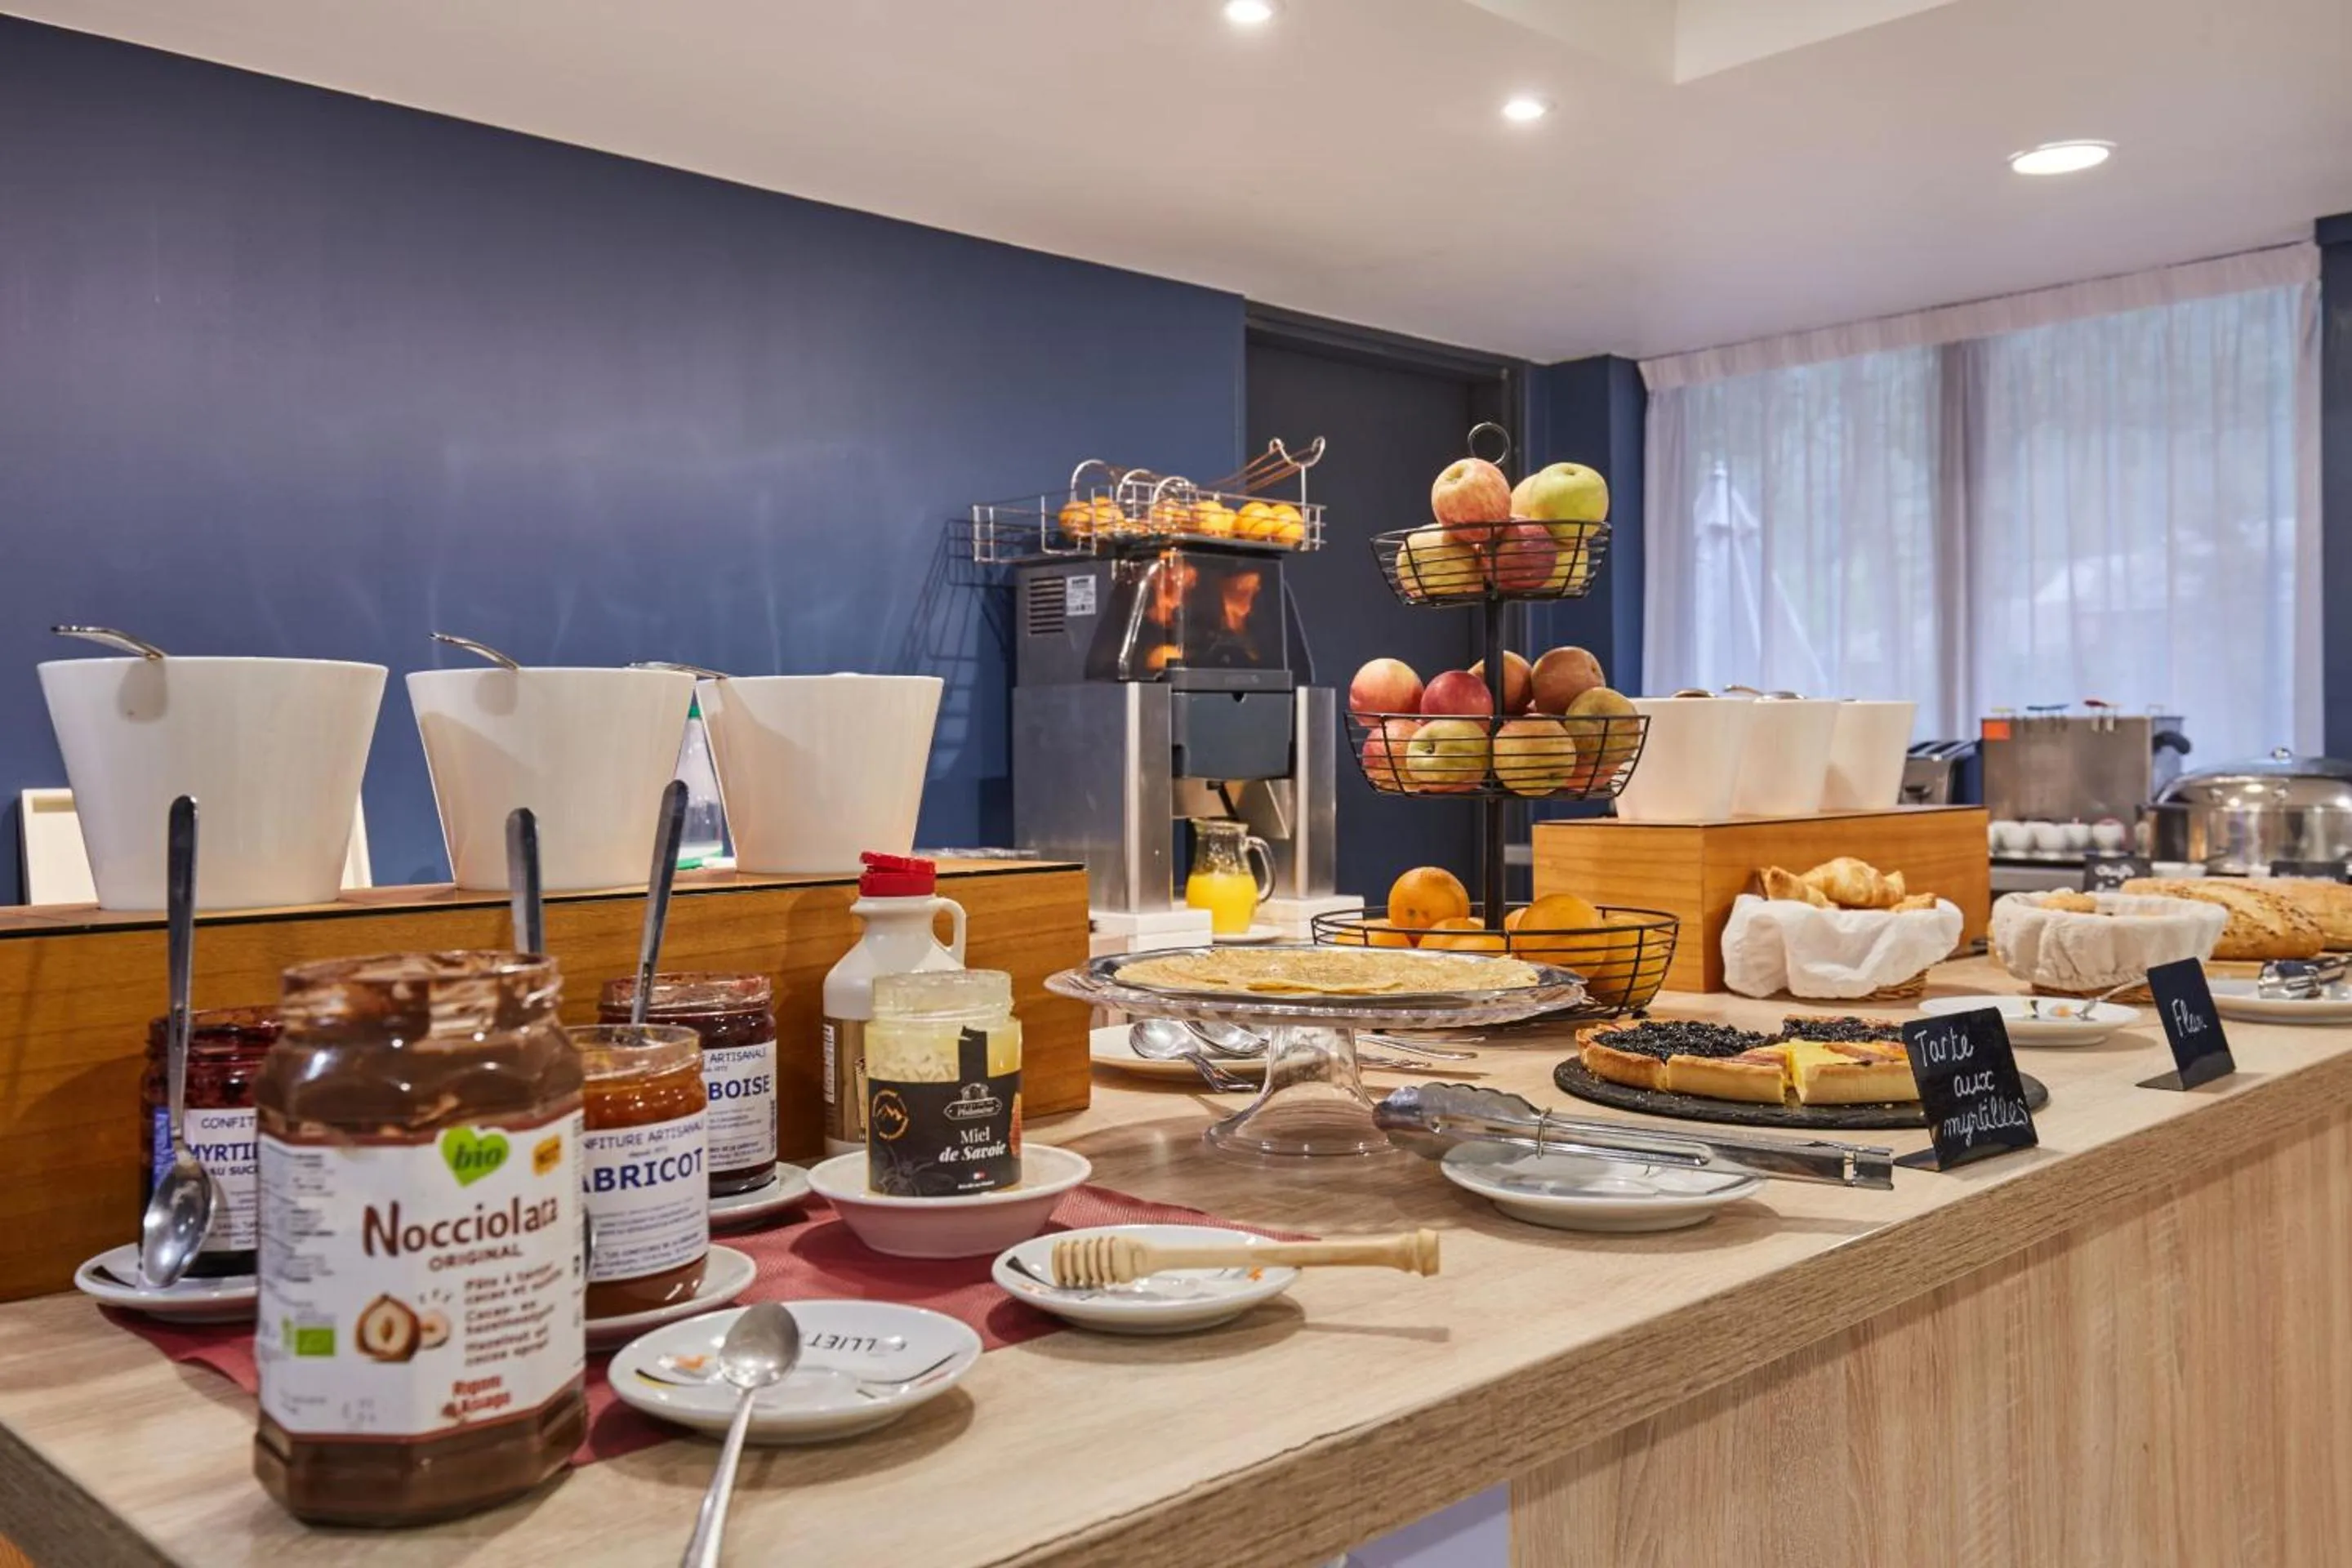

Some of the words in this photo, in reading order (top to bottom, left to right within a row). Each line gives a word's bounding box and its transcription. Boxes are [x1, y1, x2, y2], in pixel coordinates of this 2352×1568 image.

[1914, 1027, 1975, 1067] Tarte
[1953, 1071, 1995, 1098] aux
[960, 1125, 991, 1144] Miel
[1943, 1095, 2029, 1147] myrtilles
[454, 1140, 502, 1171] bio
[938, 1146, 960, 1163] de
[961, 1140, 1006, 1160] Savoie
[429, 1243, 523, 1272] ORIGINAL
